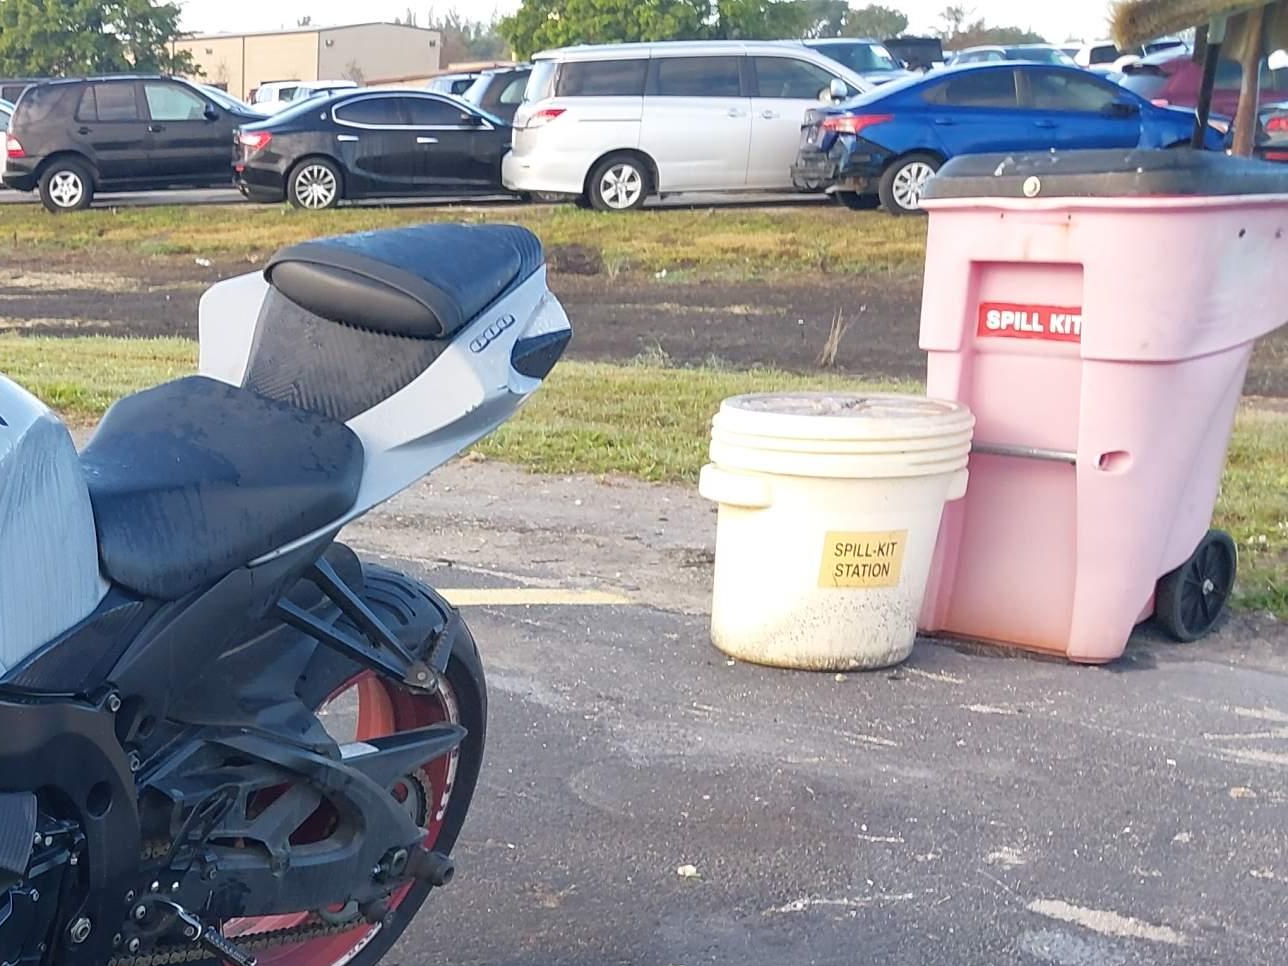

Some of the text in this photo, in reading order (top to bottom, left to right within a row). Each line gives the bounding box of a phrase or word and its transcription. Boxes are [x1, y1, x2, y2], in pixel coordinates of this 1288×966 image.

[986, 309, 1081, 336] SPILL KIT
[834, 541, 897, 558] SPILL-KIT
[834, 562, 890, 578] STATION
